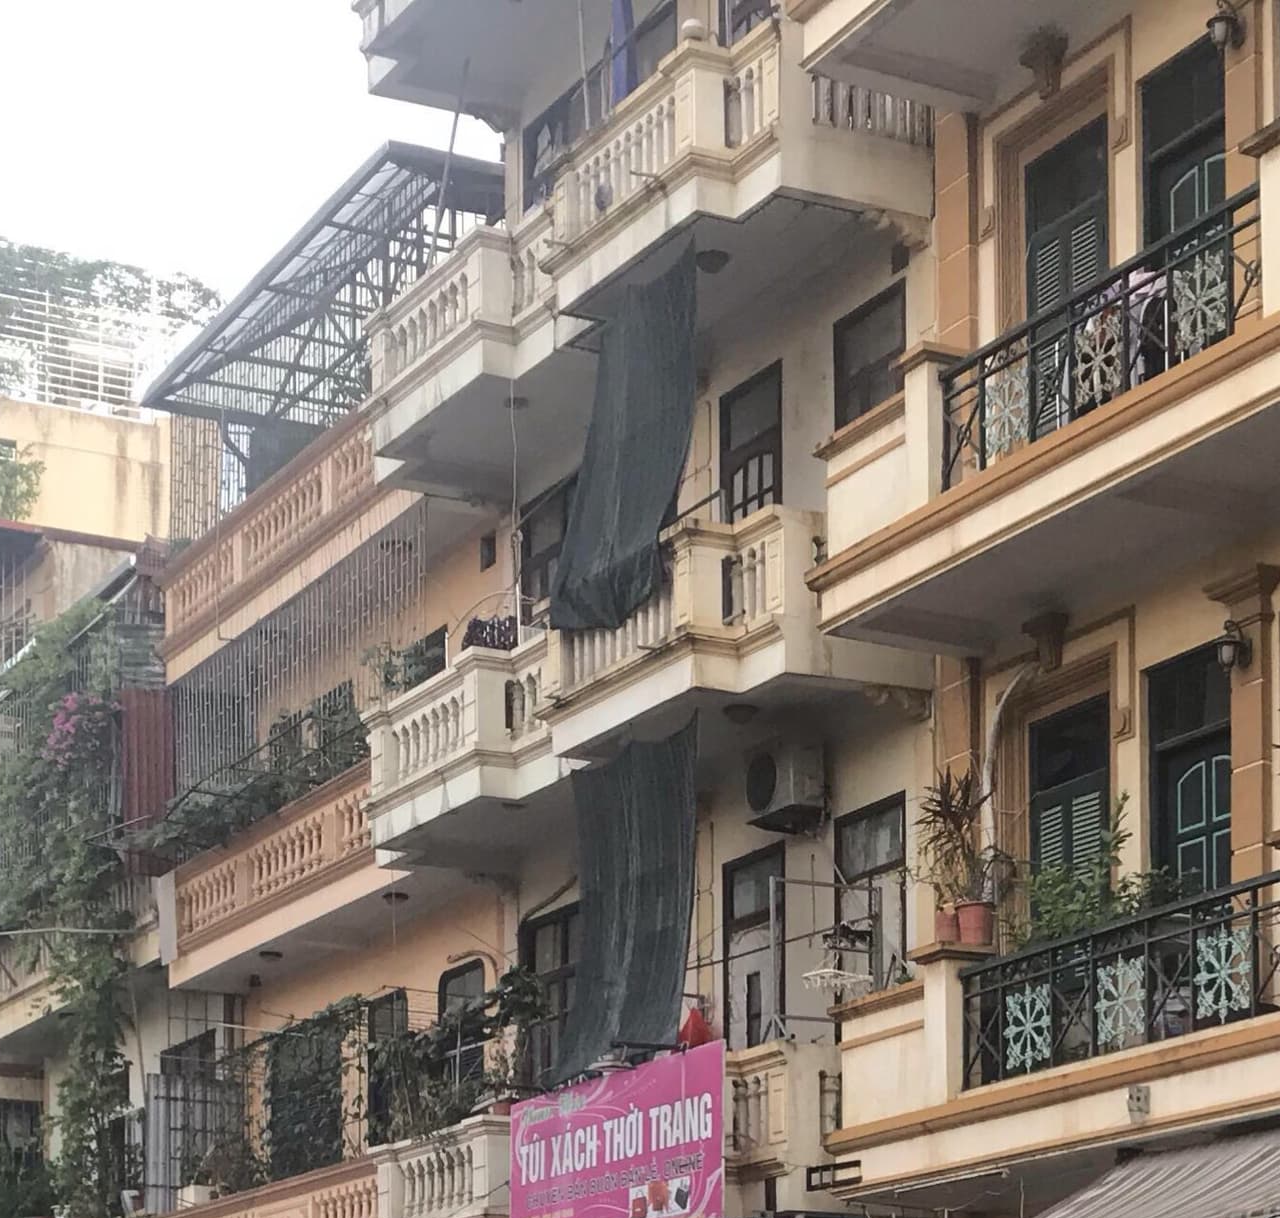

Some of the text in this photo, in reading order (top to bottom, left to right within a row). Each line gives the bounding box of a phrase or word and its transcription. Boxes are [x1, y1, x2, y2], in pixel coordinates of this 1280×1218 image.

[520, 1133, 546, 1186] TÚI
[550, 1122, 597, 1178] XÁCH
[603, 1103, 643, 1164] THỜI
[649, 1093, 713, 1152] TRANG
